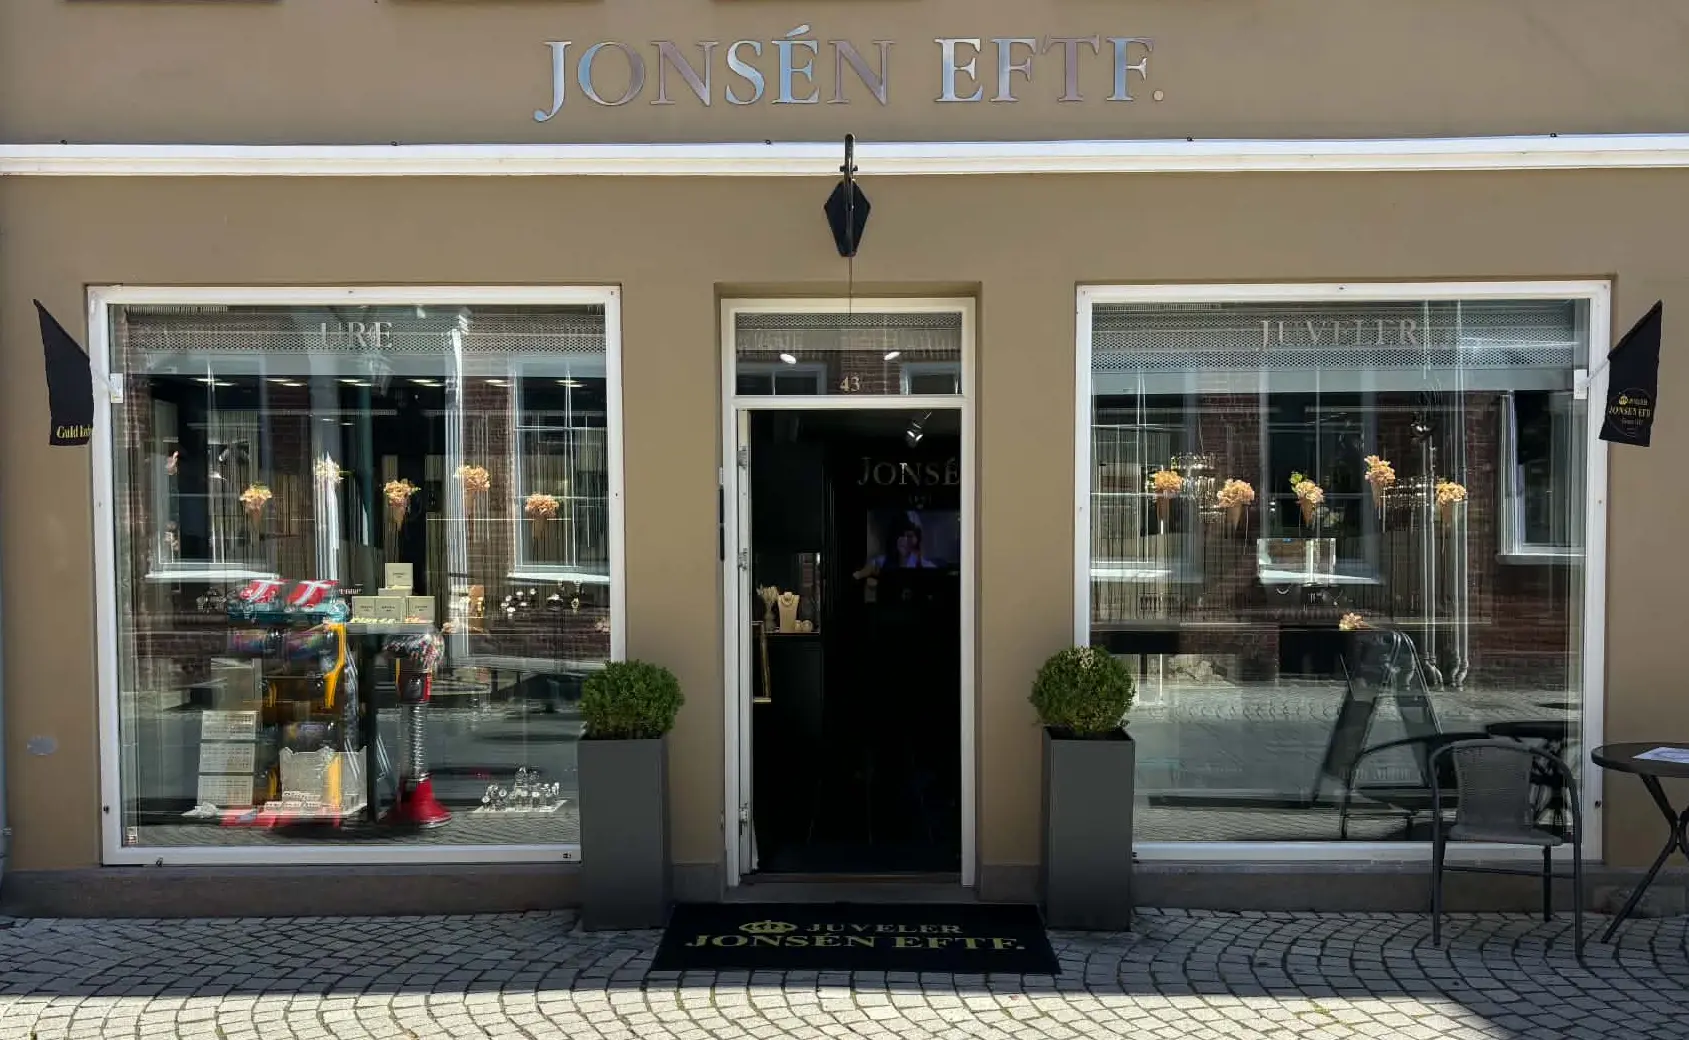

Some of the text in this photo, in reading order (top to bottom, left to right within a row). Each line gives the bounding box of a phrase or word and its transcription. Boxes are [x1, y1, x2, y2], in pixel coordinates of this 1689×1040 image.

[533, 23, 1164, 122] JONSÉN EFTF.
[840, 374, 861, 392] 43
[805, 923, 964, 933] JUVELER
[685, 932, 1025, 950] JONSÉN EFTF.
